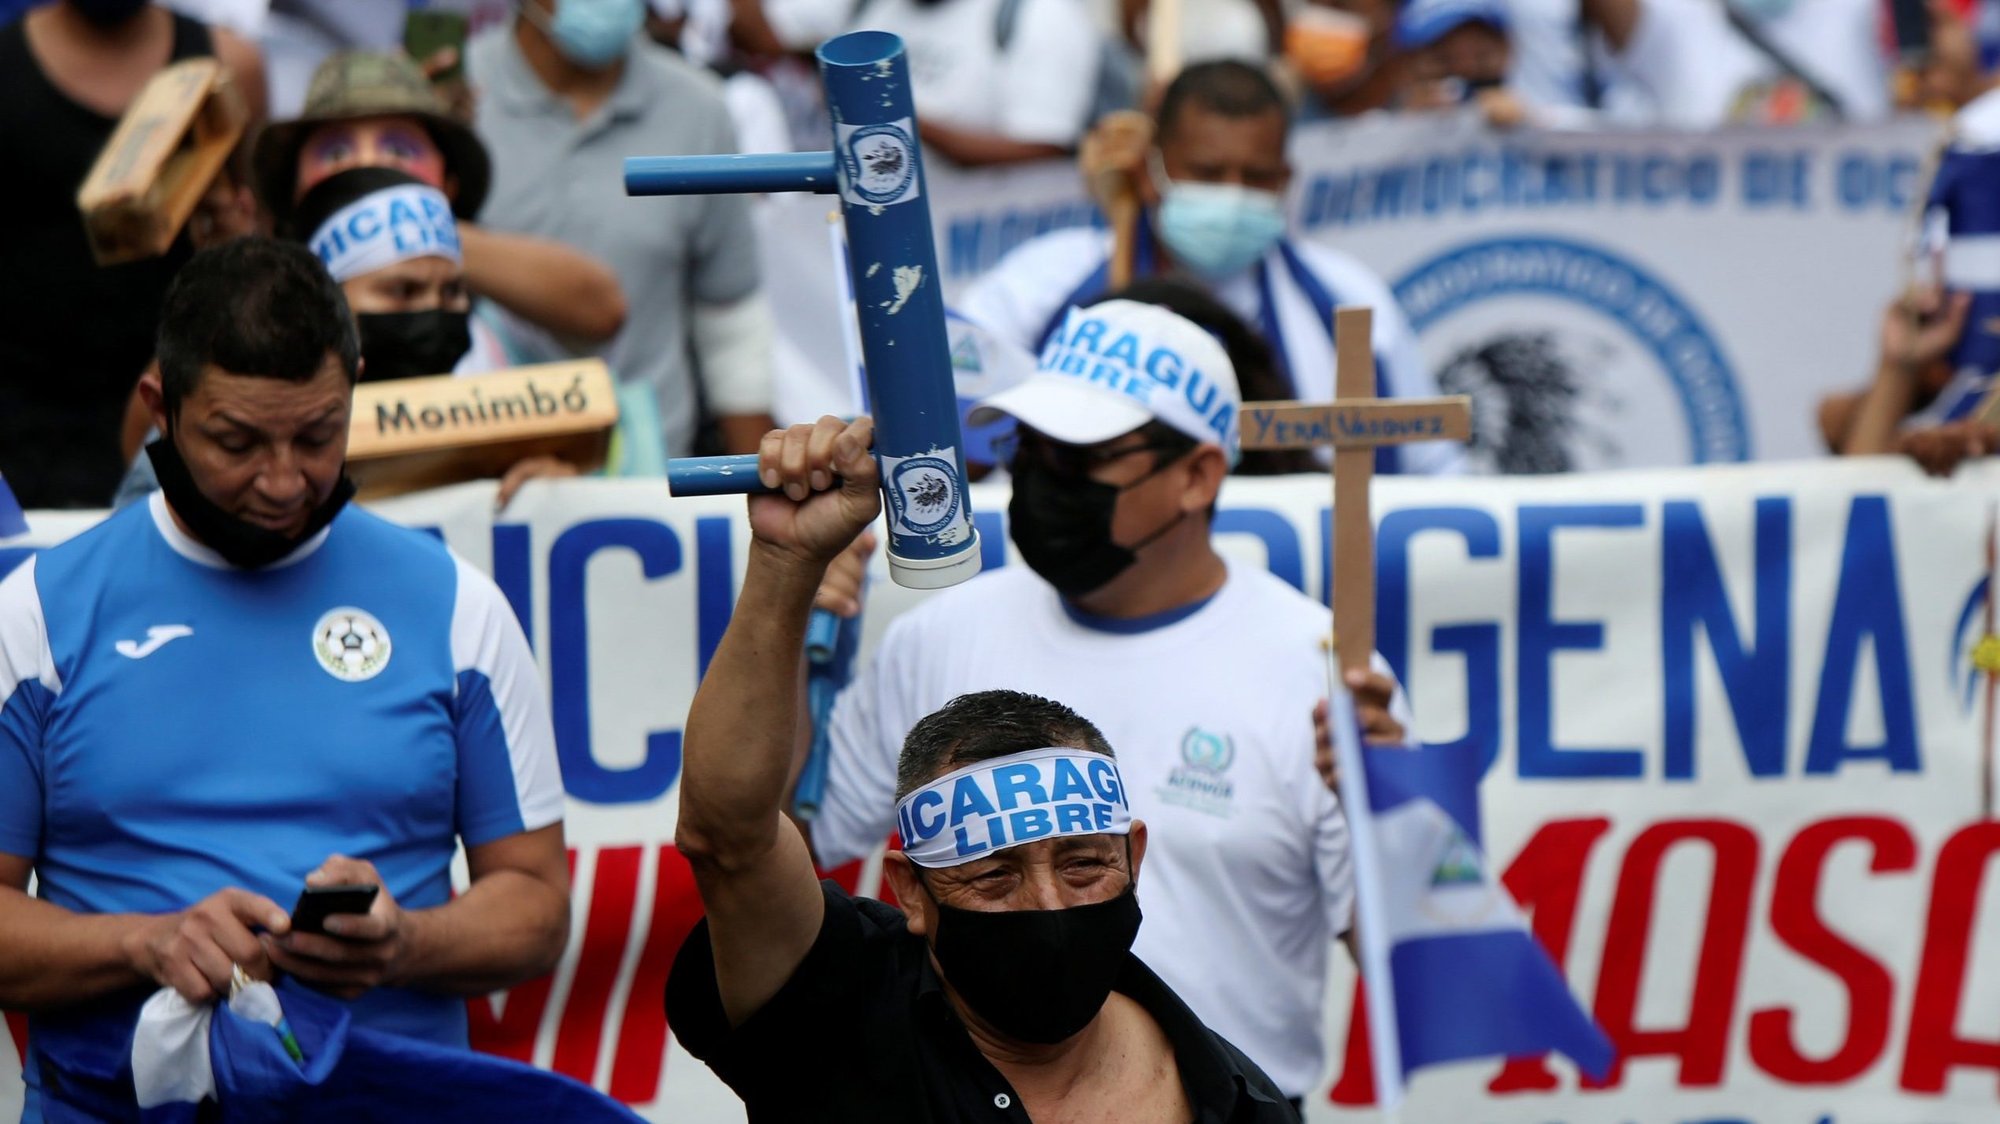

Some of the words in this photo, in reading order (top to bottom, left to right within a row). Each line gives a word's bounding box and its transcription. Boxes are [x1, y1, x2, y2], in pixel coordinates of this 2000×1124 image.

[376, 375, 587, 436] Monimbó
[898, 758, 1129, 851] ICARAG
[955, 803, 1112, 857] LIBRE
